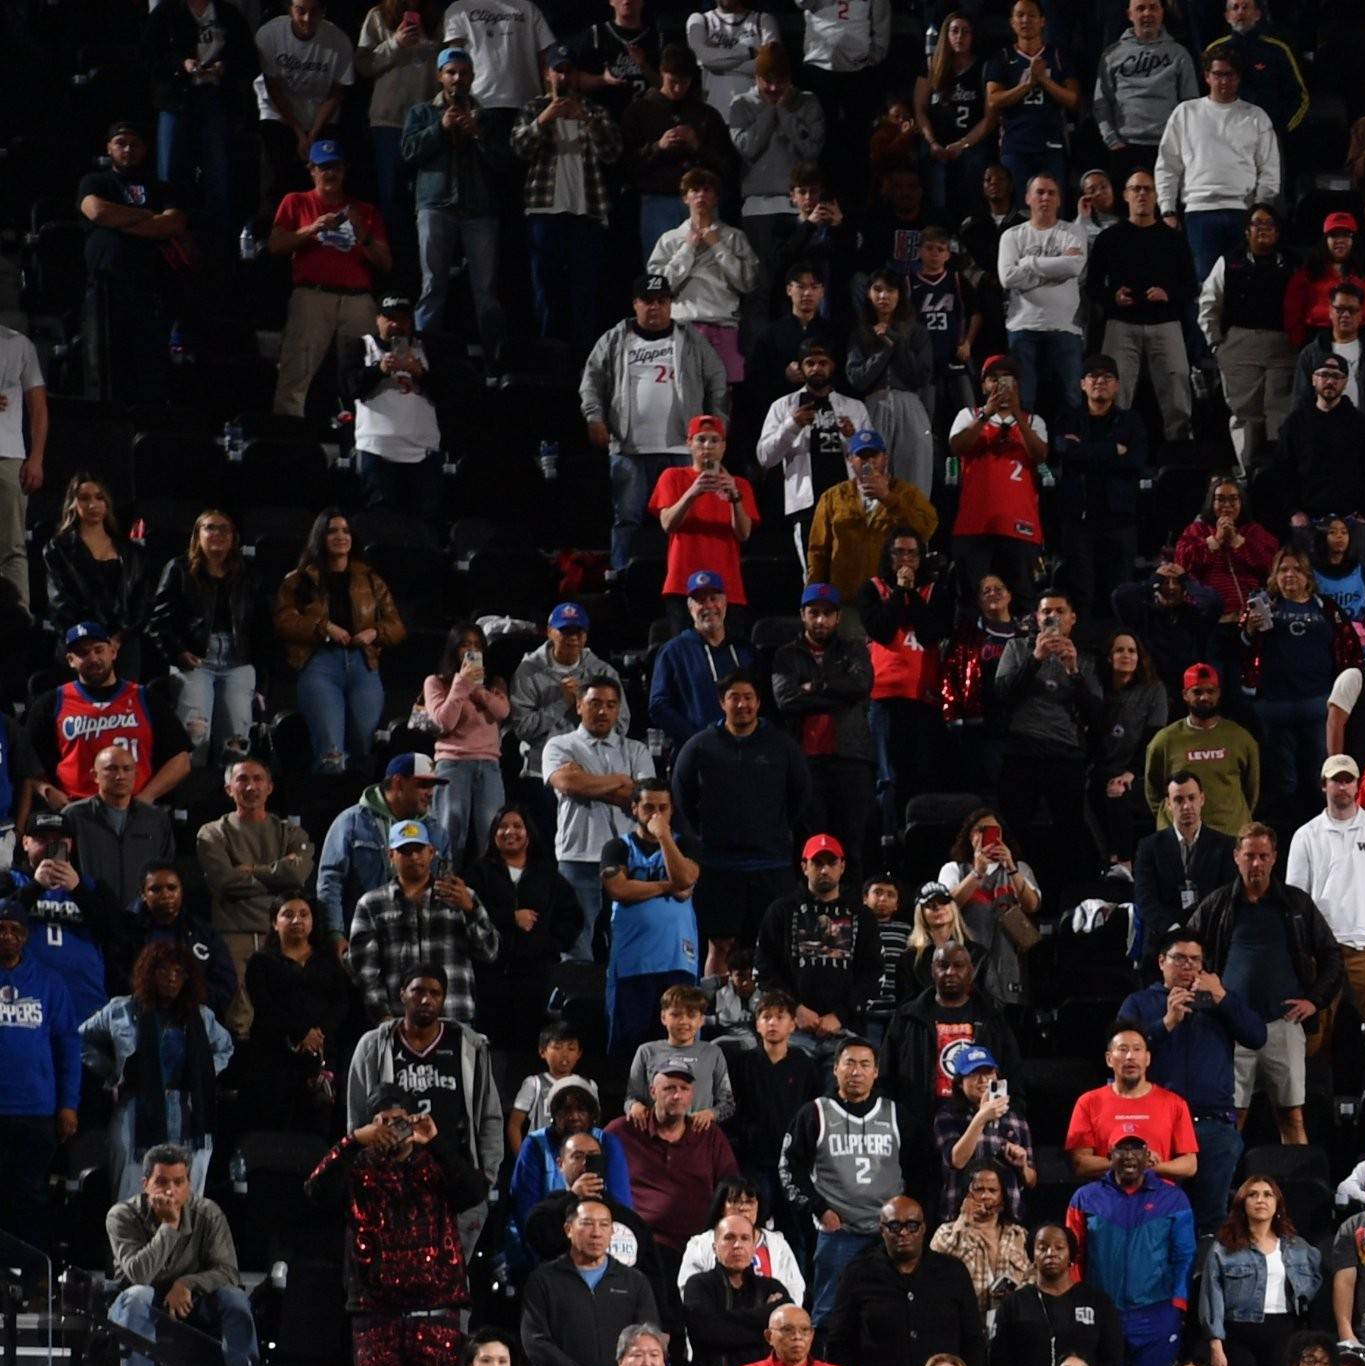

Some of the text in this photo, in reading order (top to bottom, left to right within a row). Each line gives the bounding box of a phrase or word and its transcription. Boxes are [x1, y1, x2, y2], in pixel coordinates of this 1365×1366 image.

[1119, 49, 1173, 81] Clips
[955, 106, 970, 128] 2
[921, 293, 955, 312] LA
[926, 313, 949, 331] 23
[1010, 460, 1023, 482] 2
[60, 708, 140, 741] Clippers
[192, 942, 210, 961] C
[828, 1132, 893, 1157] CLIPPERS
[856, 1157, 872, 1185] 2
